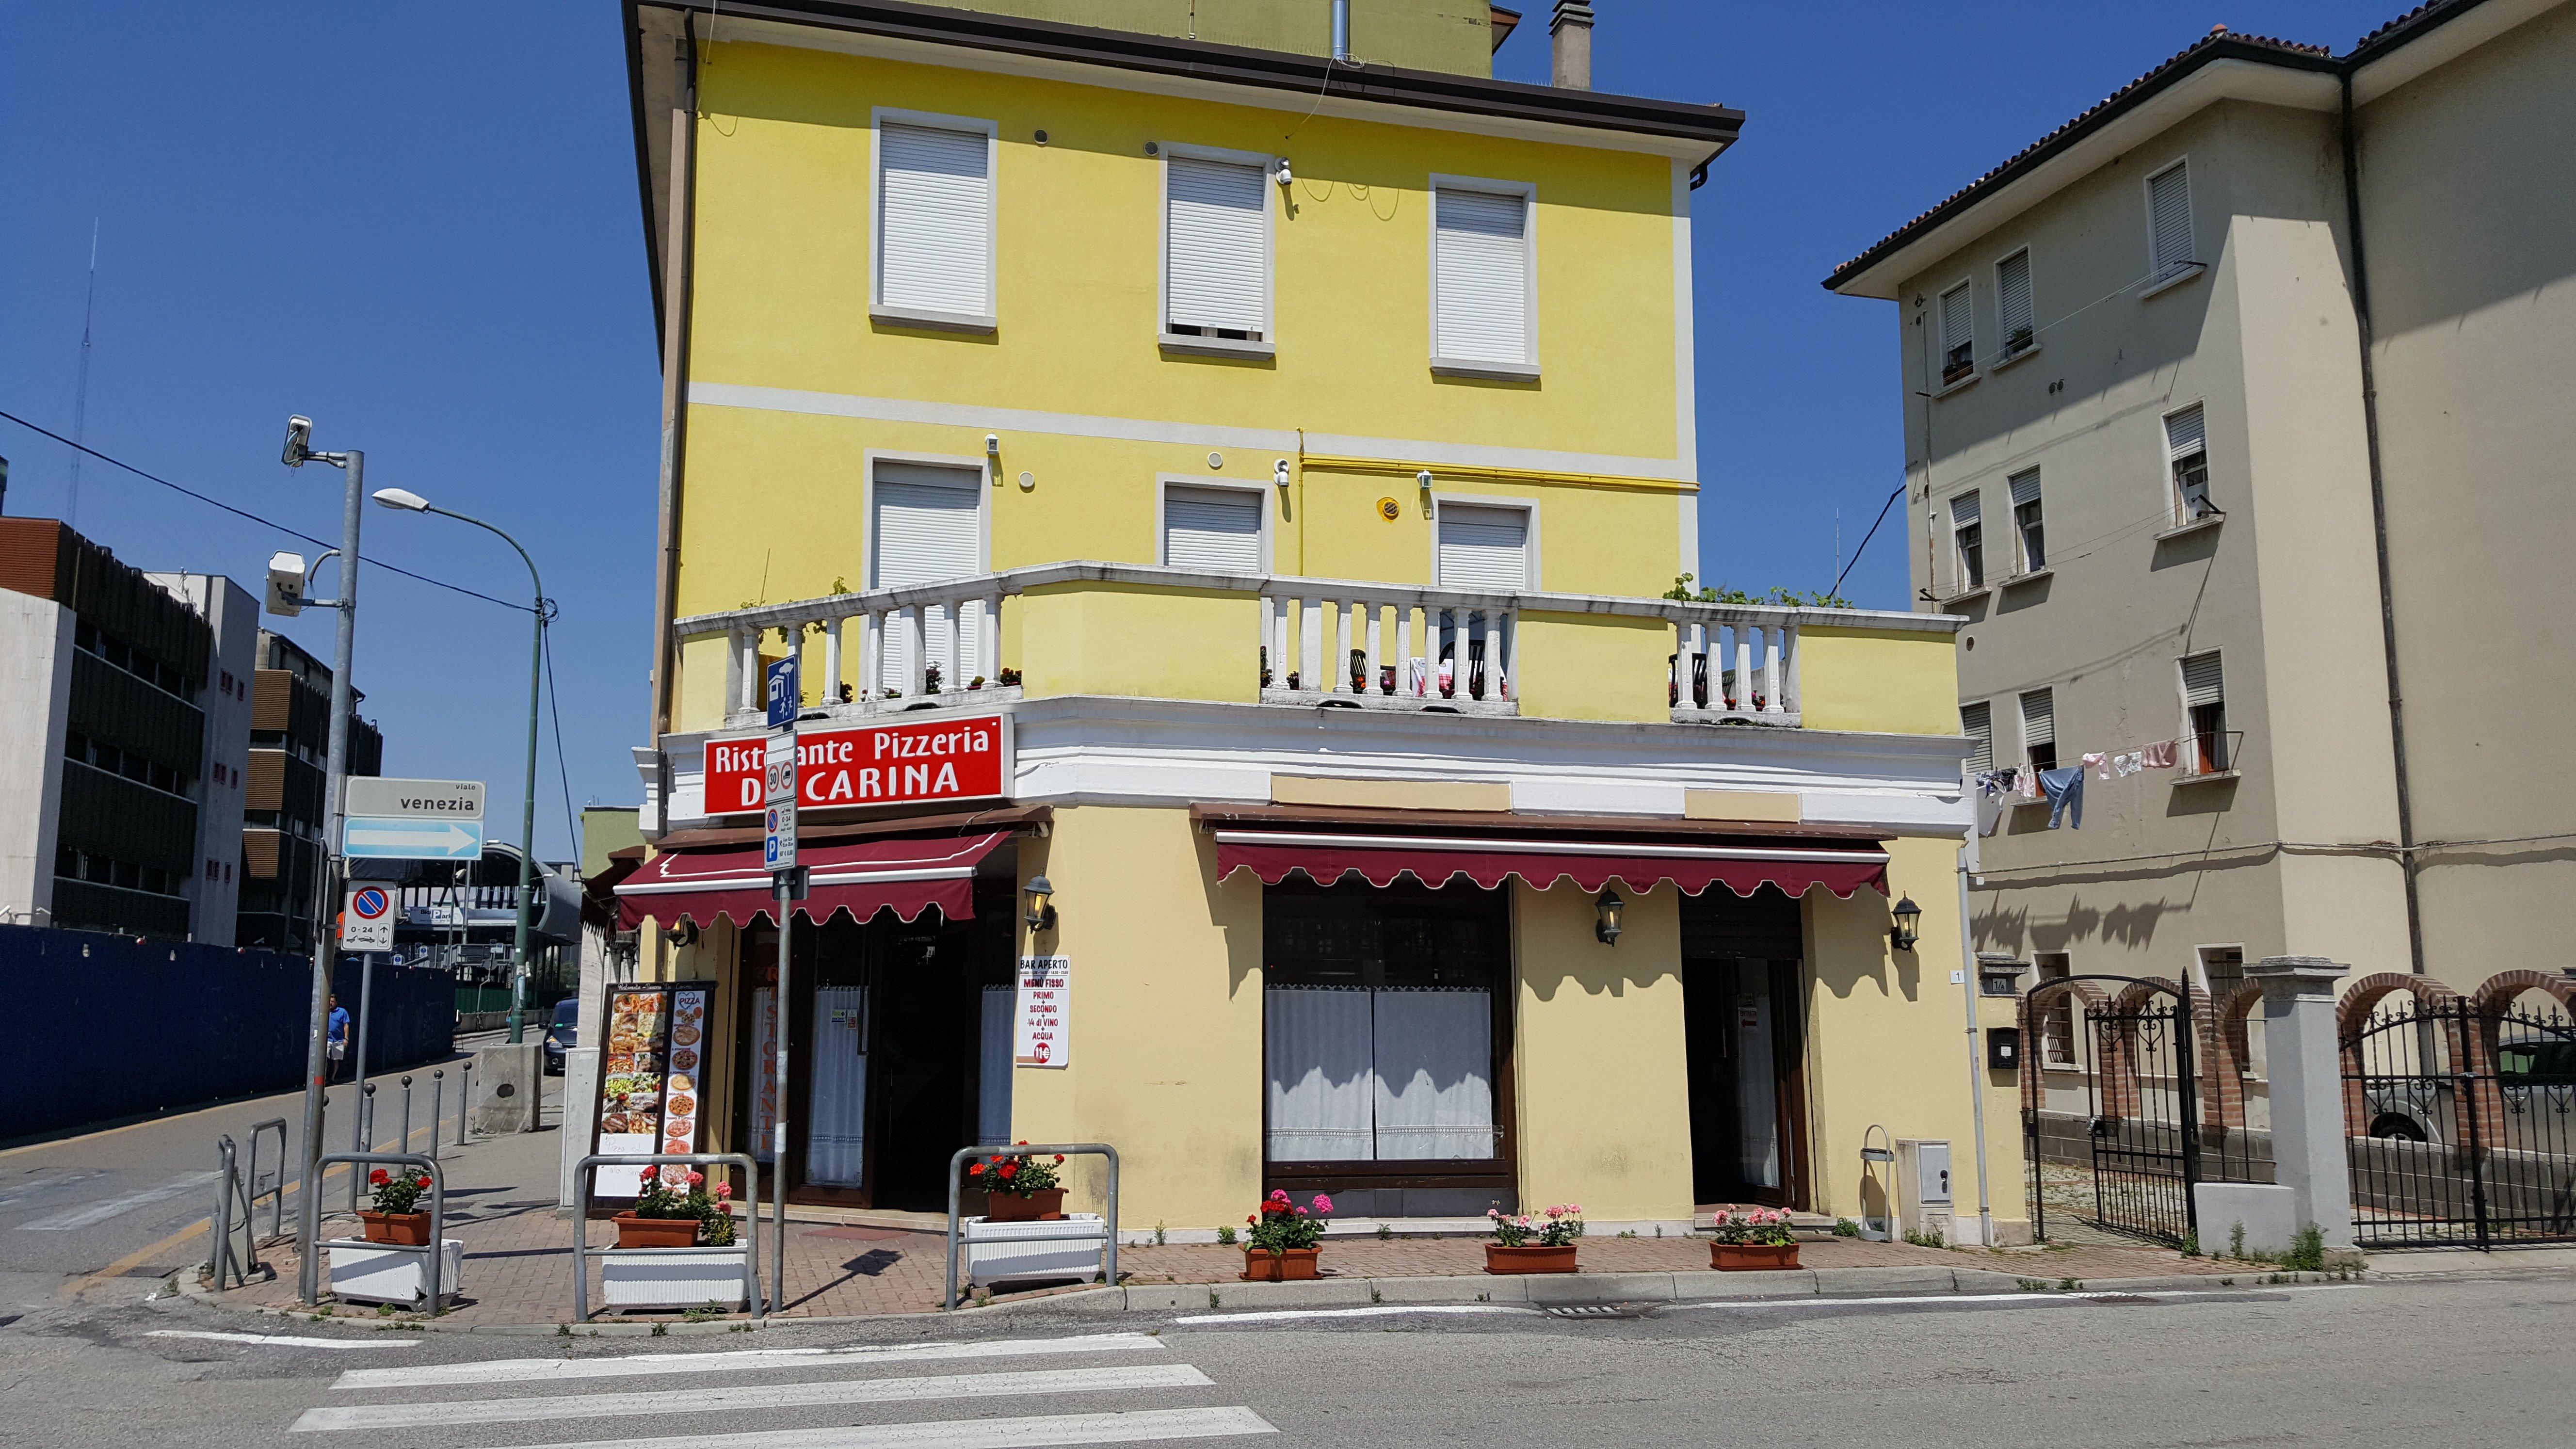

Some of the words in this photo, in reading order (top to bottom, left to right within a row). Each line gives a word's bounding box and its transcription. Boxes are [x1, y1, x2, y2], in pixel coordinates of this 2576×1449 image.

[716, 740, 853, 773] Ristante
[874, 726, 988, 759] Pizzeria
[741, 778, 761, 806] D
[806, 762, 959, 801] CARINA
[770, 773, 777, 785] 30
[400, 797, 474, 810] venezia
[1020, 960, 1035, 969] BAR
[1038, 960, 1068, 969] APERTO
[1956, 972, 1960, 981] 1
[1024, 977, 1044, 988] MENÙ
[1046, 979, 1064, 988] FISSO
[1033, 991, 1054, 999] PRIMO
[1043, 1018, 1058, 1027] VINO
[1032, 1032, 1053, 1040] ACQUA
[1035, 1046, 1050, 1059] 11€
[760, 967, 778, 1150] RISTORANTE
